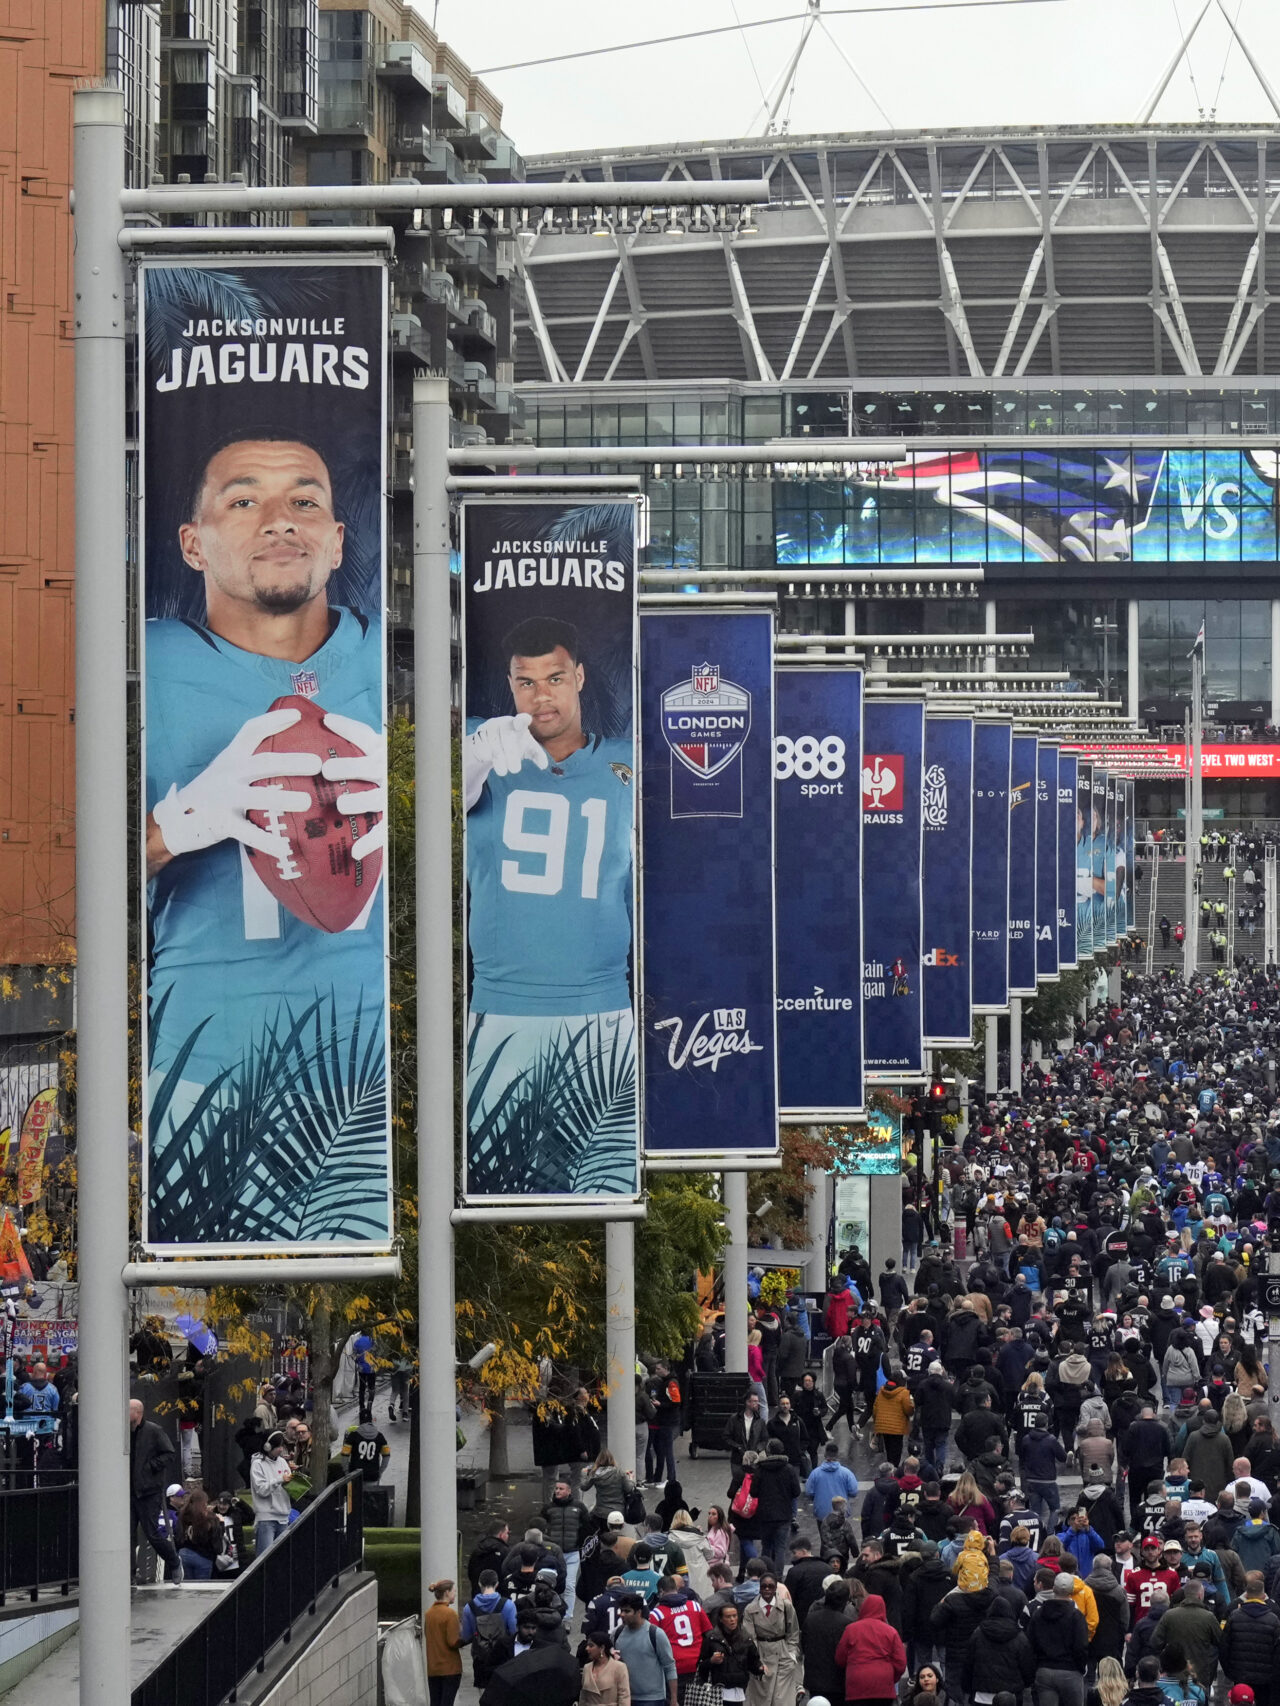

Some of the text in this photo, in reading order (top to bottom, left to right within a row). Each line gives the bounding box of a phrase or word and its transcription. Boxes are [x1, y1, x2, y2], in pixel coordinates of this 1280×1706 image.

[182, 318, 345, 337] JACKSONVILLE
[156, 343, 370, 392] JAGUARS
[1178, 473, 1240, 540] VS
[492, 540, 608, 554] JACKSONVILLE
[473, 557, 625, 593] JAGUARS
[296, 682, 316, 694] NFL
[695, 677, 716, 692] NFL
[667, 716, 744, 730] LONDON
[775, 736, 846, 779] 888
[1200, 754, 1222, 767] EVEL
[1225, 754, 1245, 767] TWO
[1247, 754, 1274, 767] WEST
[800, 782, 844, 798] sport
[863, 814, 904, 825] RAUSS
[501, 789, 608, 900] 91
[923, 948, 959, 967] dEx
[775, 994, 853, 1011] ccenture
[716, 1010, 744, 1028] LAS
[654, 1012, 764, 1072] Vegas
[857, 1336, 872, 1354] 90
[906, 1353, 922, 1371] 32
[357, 1440, 376, 1461] 90
[625, 1580, 650, 1588] ENGRAM
[674, 1614, 694, 1646] 9
